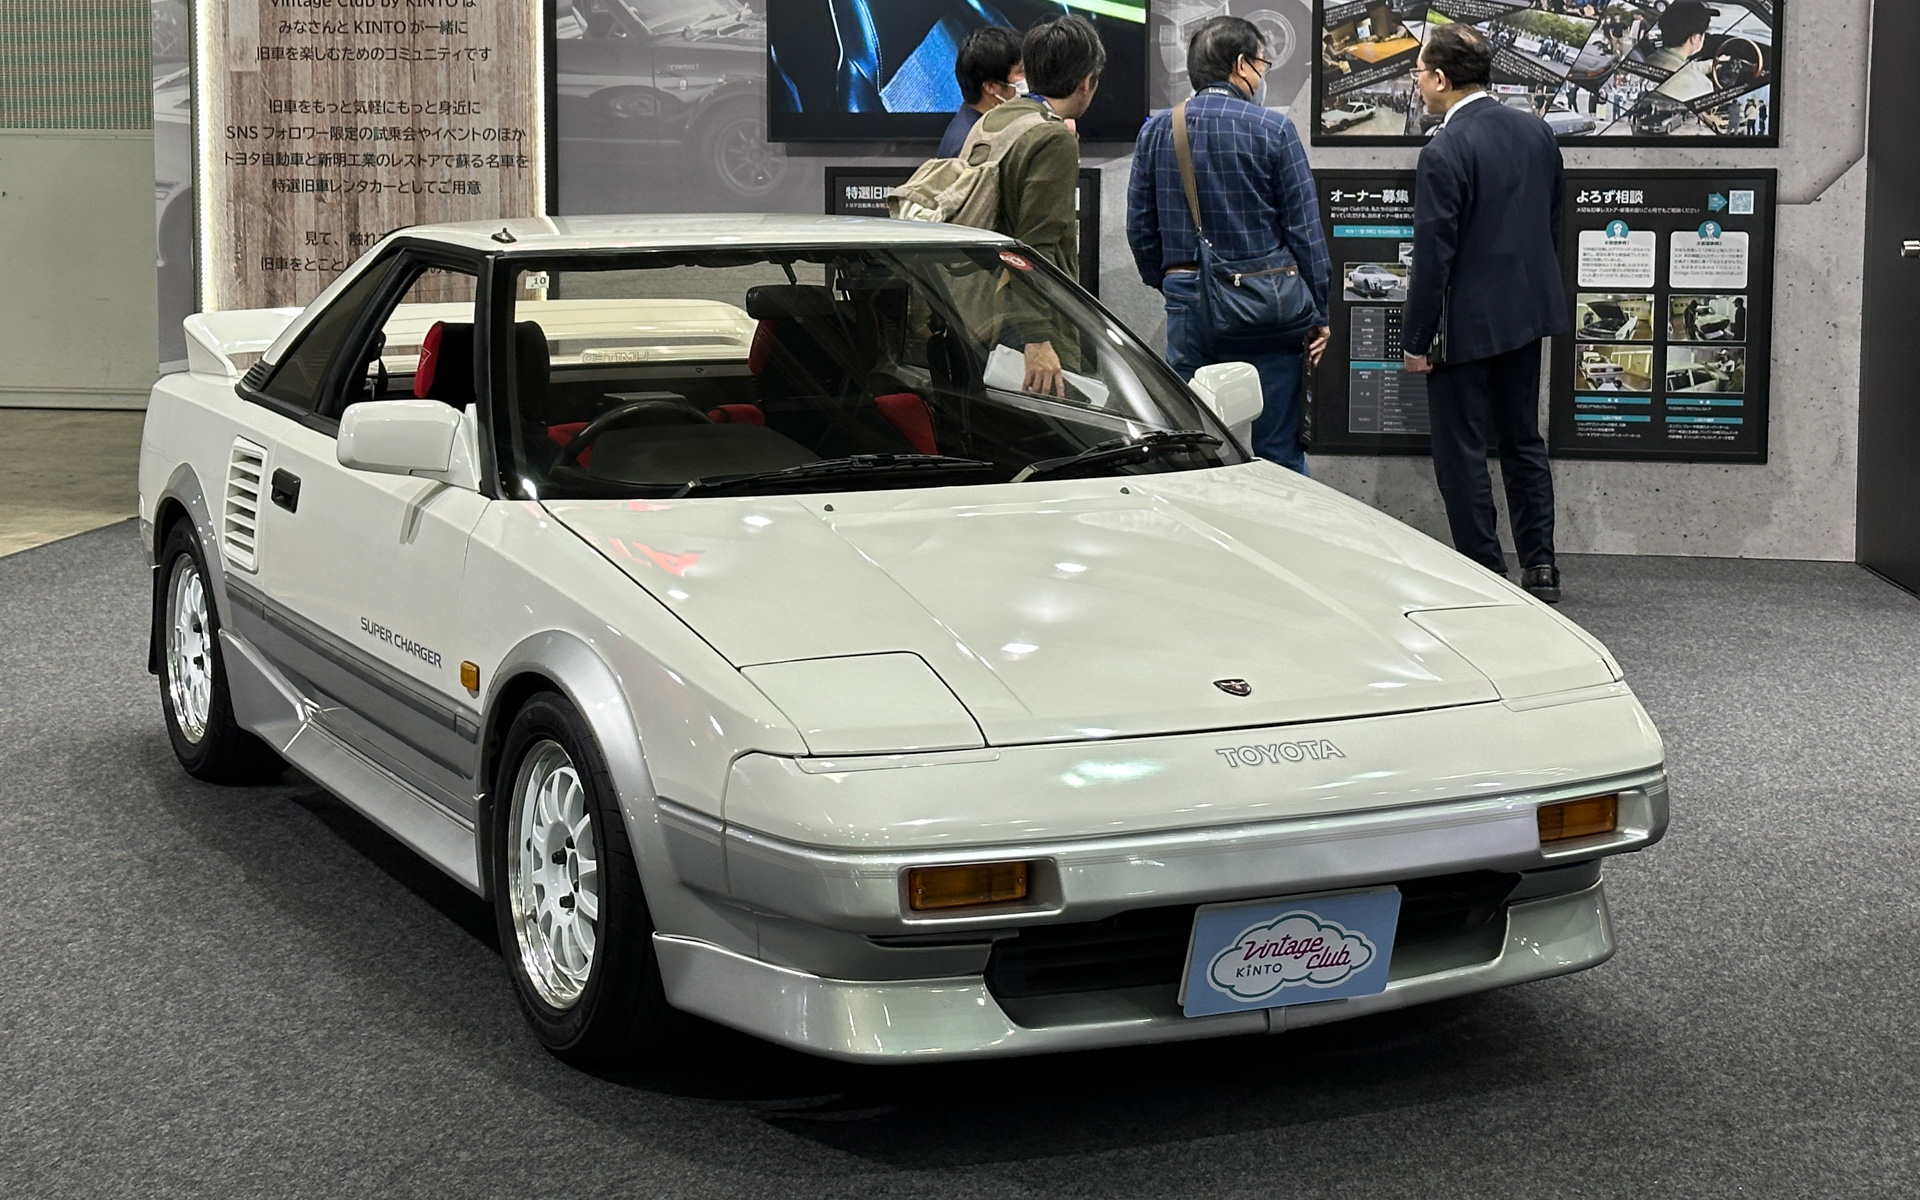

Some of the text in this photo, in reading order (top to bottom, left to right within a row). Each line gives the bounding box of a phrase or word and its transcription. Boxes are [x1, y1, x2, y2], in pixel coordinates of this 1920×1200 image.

[354, 21, 406, 34] KINTO
[257, 46, 491, 62] 旧車を楽しむためのコミュニティです
[269, 100, 481, 115] 旧車をもっと気軽にもっと身近に
[225, 153, 529, 169] トヨタ自動車と新明工業のレストアで蘇る名車を
[272, 178, 481, 194] 特選旧車レンタカーとしてご用意
[1330, 189, 1409, 203] オーナー募集
[1576, 190, 1643, 204] よろず相談
[360, 616, 443, 669] SUPER CHARGER
[1215, 739, 1346, 768] TOYOTA
[1243, 934, 1324, 960] Vintage
[1236, 963, 1282, 978] KINTO
